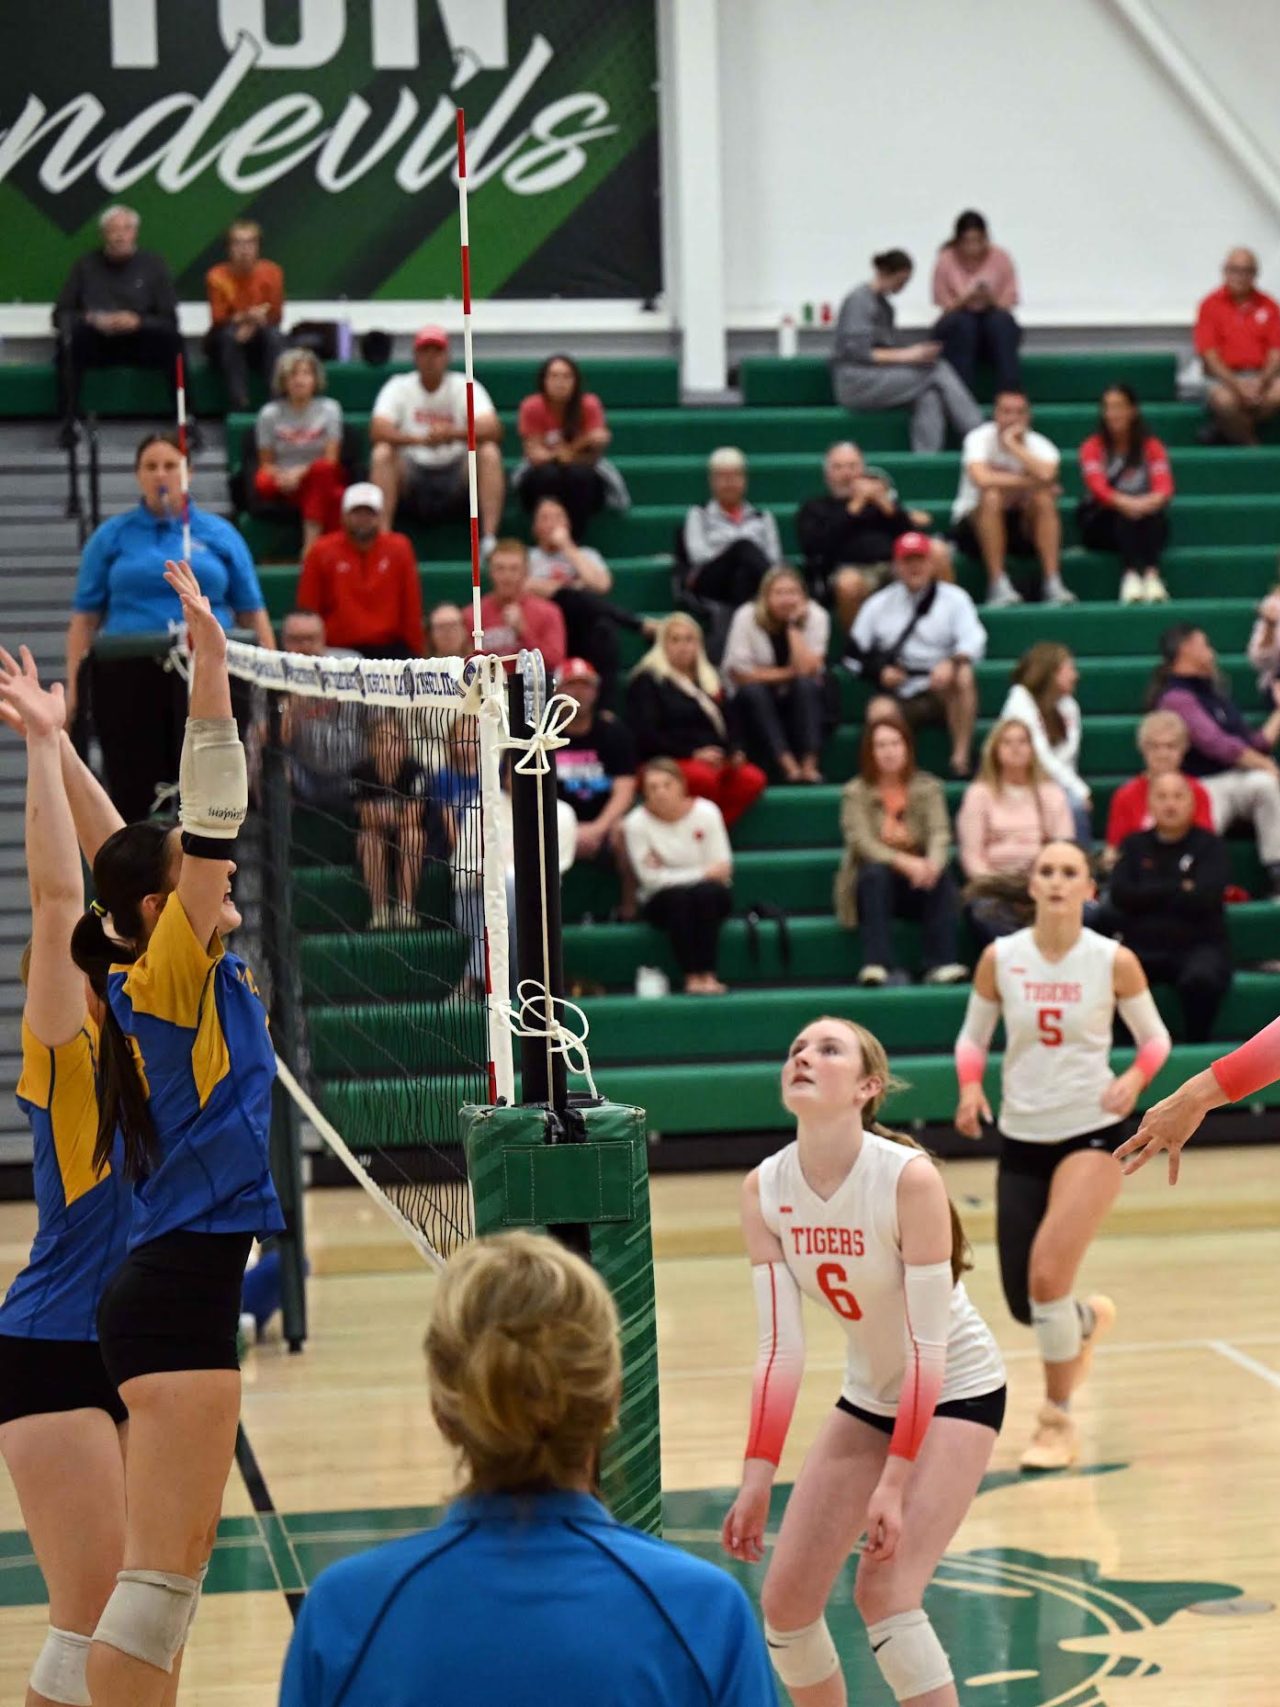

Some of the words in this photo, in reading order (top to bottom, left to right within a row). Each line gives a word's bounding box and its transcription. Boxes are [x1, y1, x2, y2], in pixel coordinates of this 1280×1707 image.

[1023, 982, 1082, 1002] TIGERS
[1037, 1008, 1064, 1047] 5
[791, 1227, 865, 1257] TIGERS
[816, 1262, 862, 1321] 6
